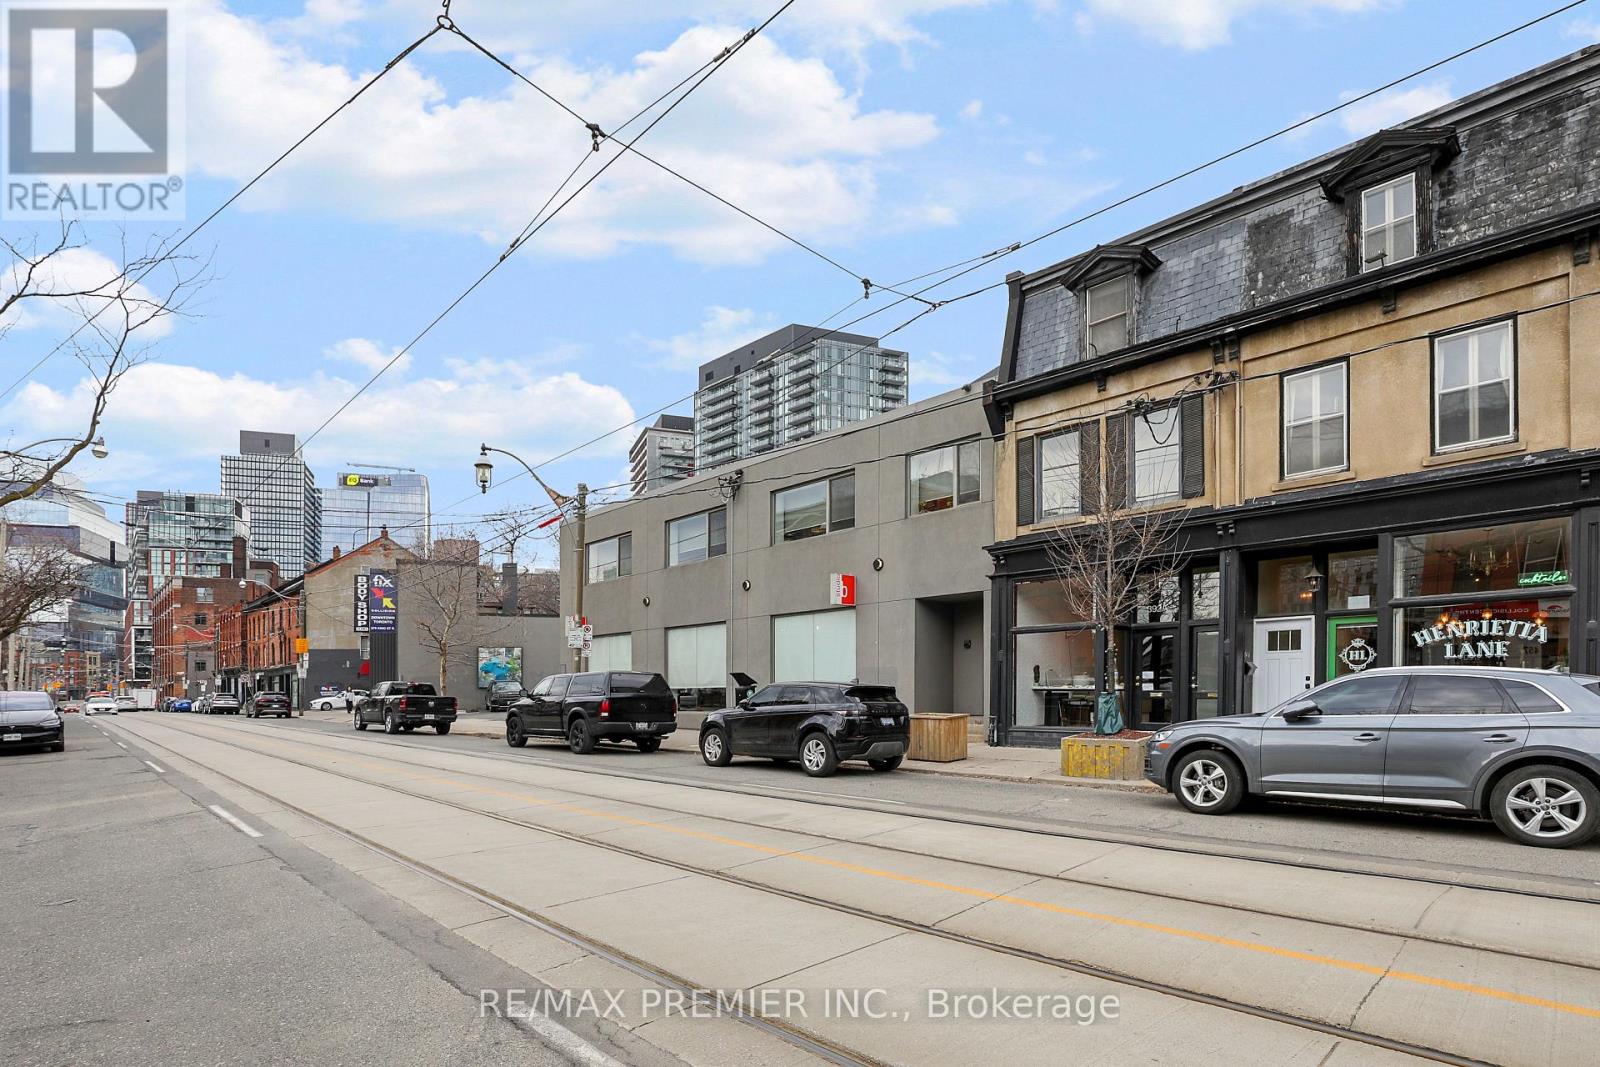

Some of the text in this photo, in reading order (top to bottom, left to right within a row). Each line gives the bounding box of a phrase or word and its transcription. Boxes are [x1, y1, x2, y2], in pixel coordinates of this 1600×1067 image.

[357, 576, 367, 600] BODY
[1519, 570, 1568, 584] cocktails
[357, 602, 368, 626] SHOP
[1412, 618, 1548, 648] HENRIETTA
[1444, 640, 1511, 659] LANE
